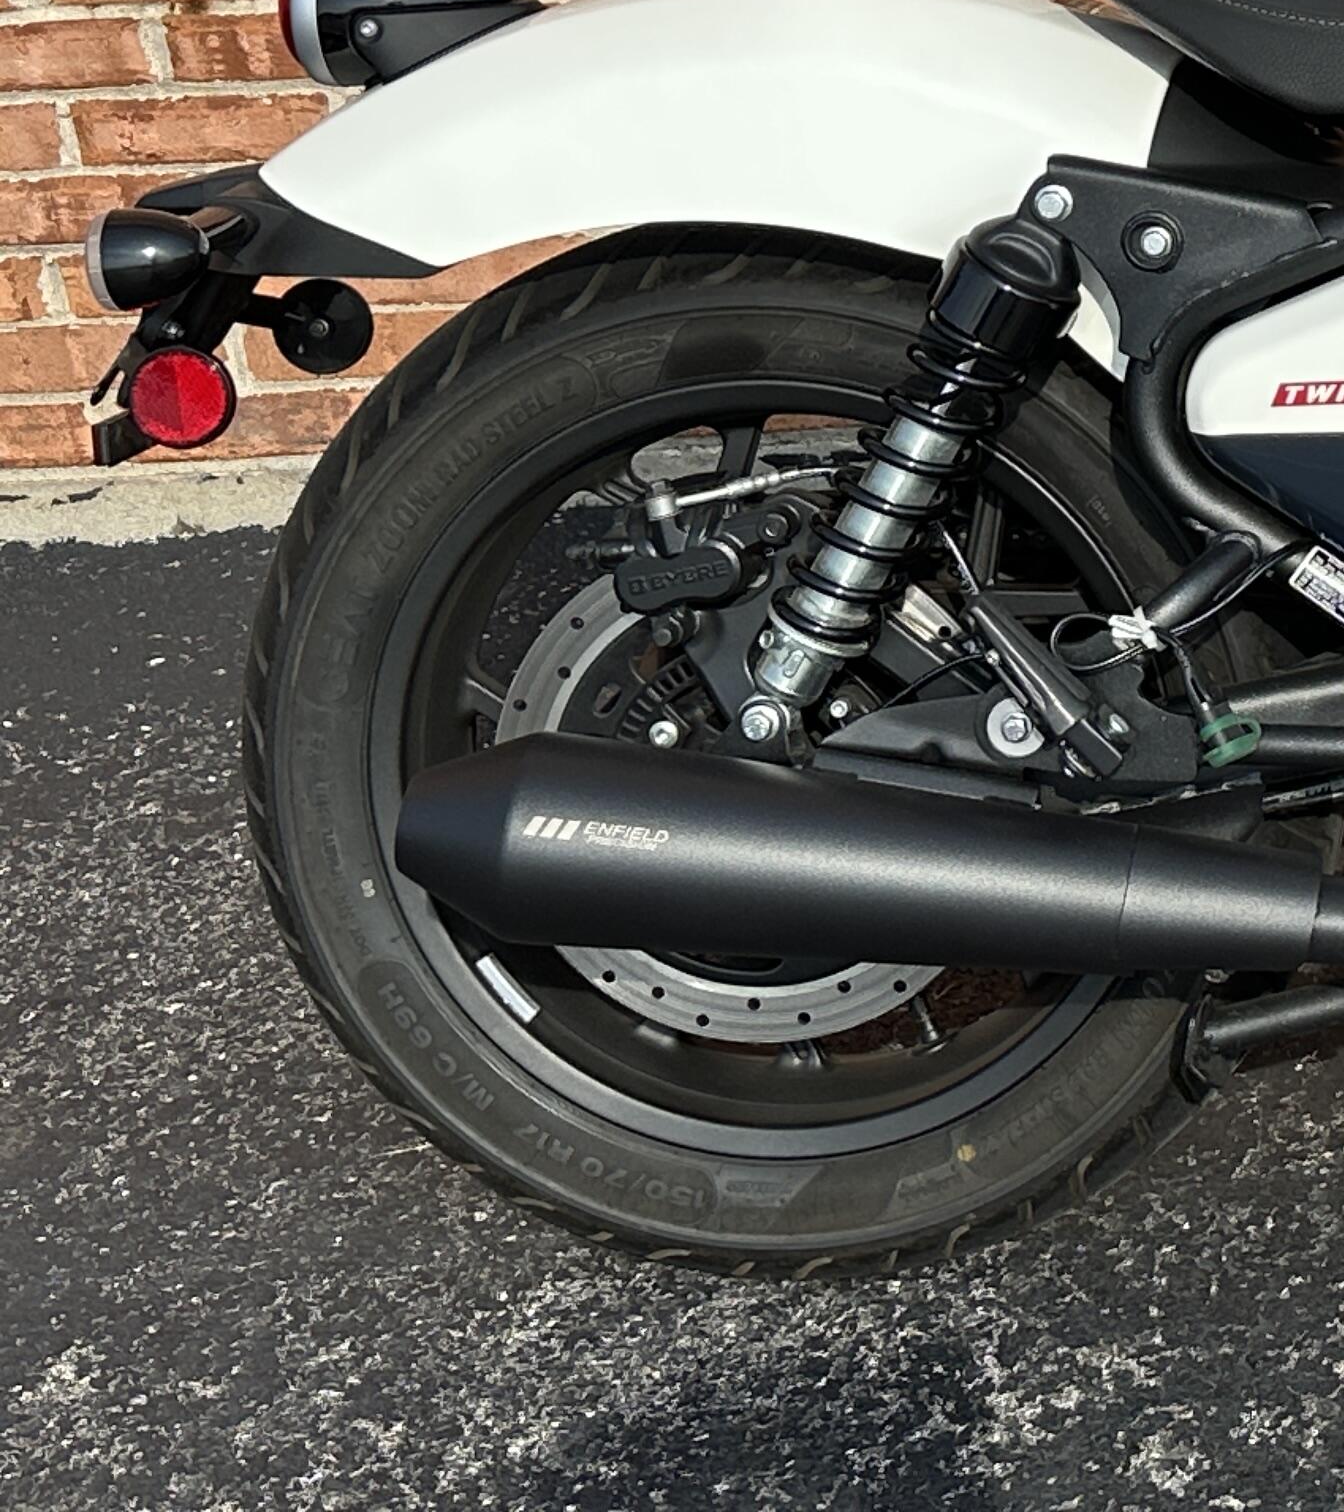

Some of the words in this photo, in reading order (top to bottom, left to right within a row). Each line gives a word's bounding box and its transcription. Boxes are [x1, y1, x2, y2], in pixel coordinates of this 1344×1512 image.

[584, 820, 670, 843] ENFIELD
[377, 981, 433, 1049] 69H
[432, 1051, 495, 1111] M/C
[512, 1123, 575, 1165] R17
[580, 1155, 705, 1209] 150/70
